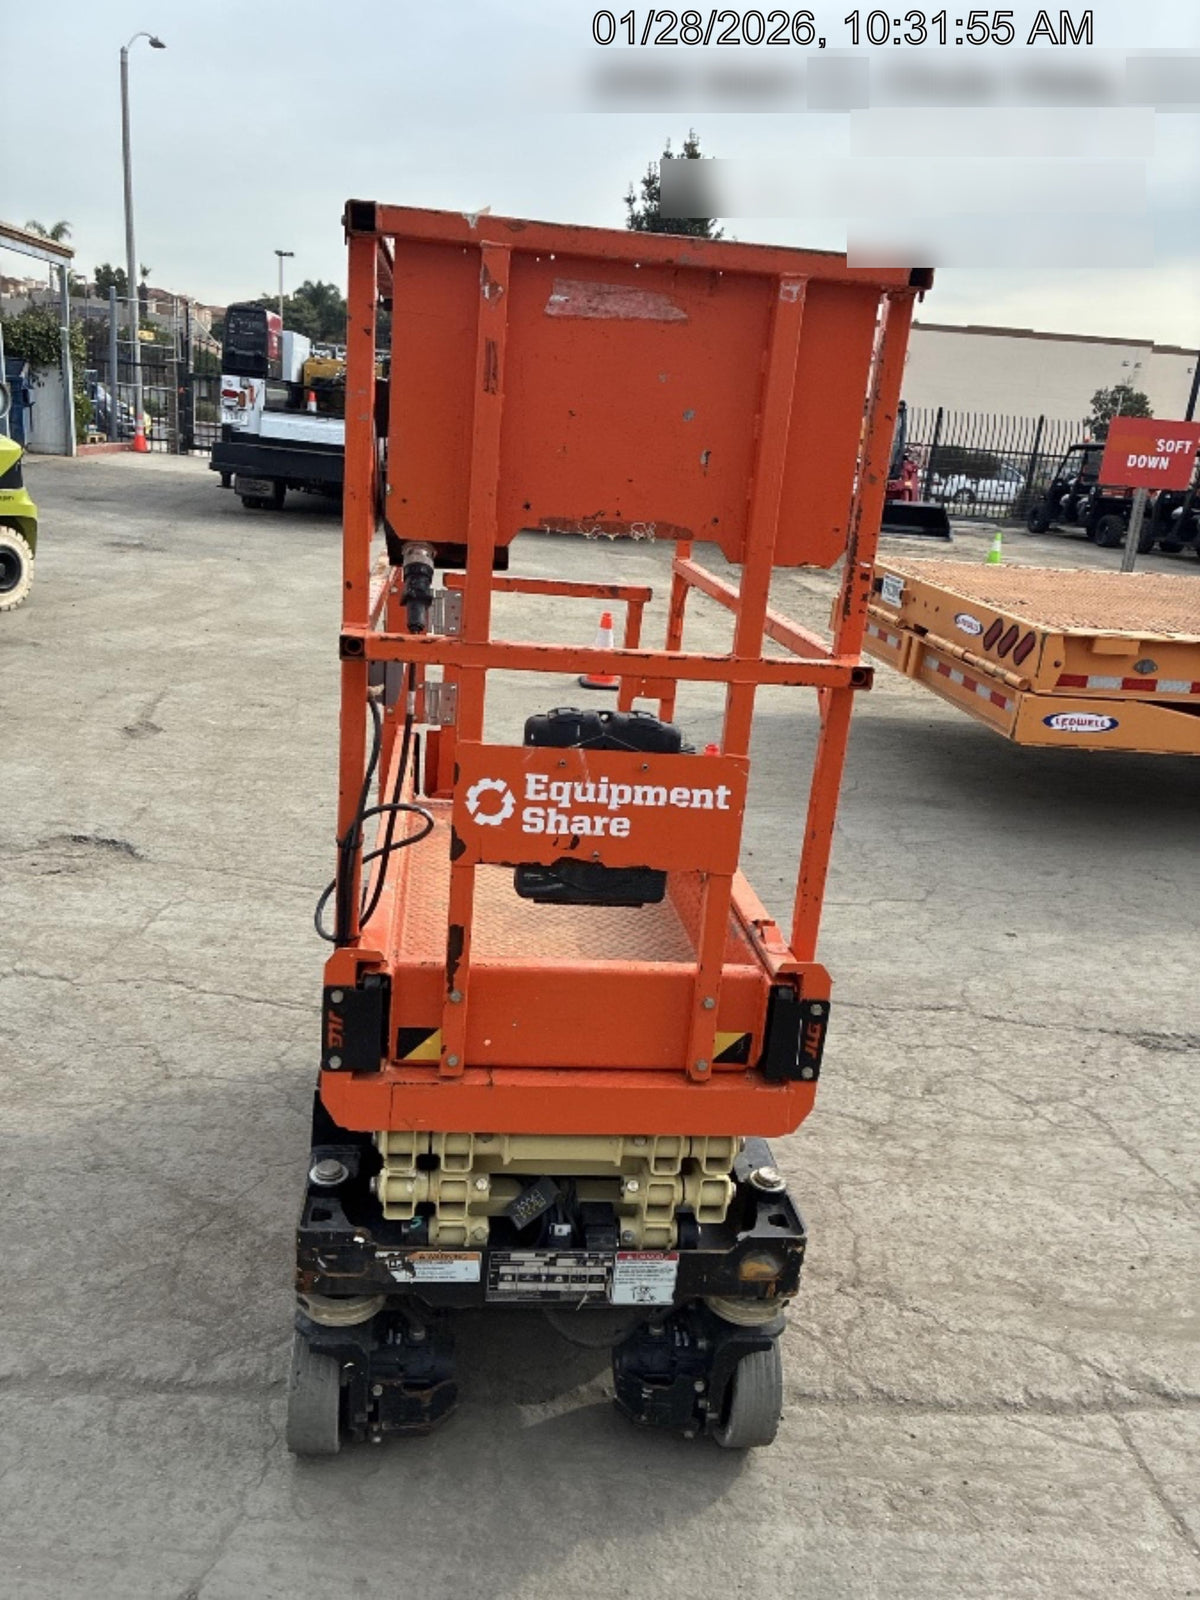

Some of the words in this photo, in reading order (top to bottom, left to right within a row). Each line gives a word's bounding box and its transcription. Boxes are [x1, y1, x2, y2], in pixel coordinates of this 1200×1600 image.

[1156, 438, 1193, 454] SOFT
[1127, 454, 1170, 470] DOWN
[524, 773, 731, 811] Equipment
[522, 806, 631, 837] Share
[805, 1022, 822, 1059] JLG
